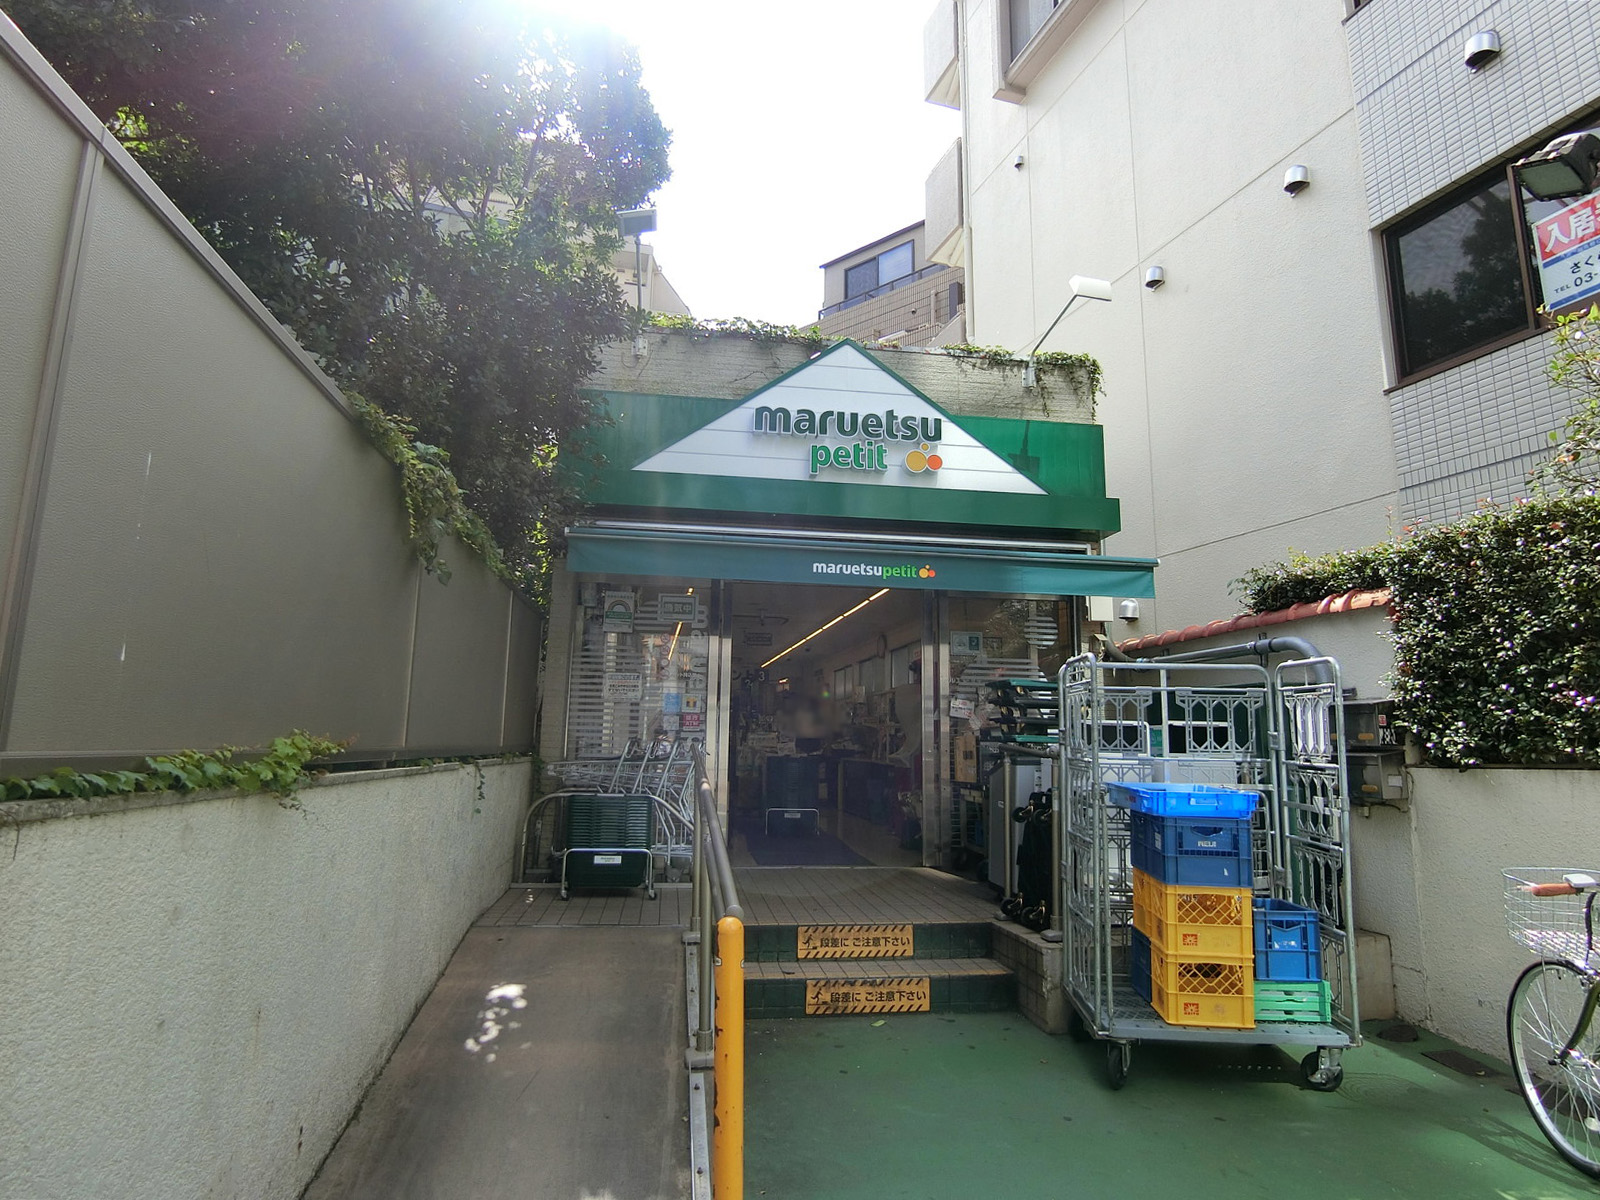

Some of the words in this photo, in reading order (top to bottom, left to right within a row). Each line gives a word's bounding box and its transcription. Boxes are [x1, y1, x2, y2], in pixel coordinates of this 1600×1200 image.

[1544, 202, 1600, 252] 入居
[1570, 251, 1600, 274] さく
[1554, 284, 1571, 294] TEL
[754, 405, 942, 442] maruetsu
[810, 441, 888, 474] petit
